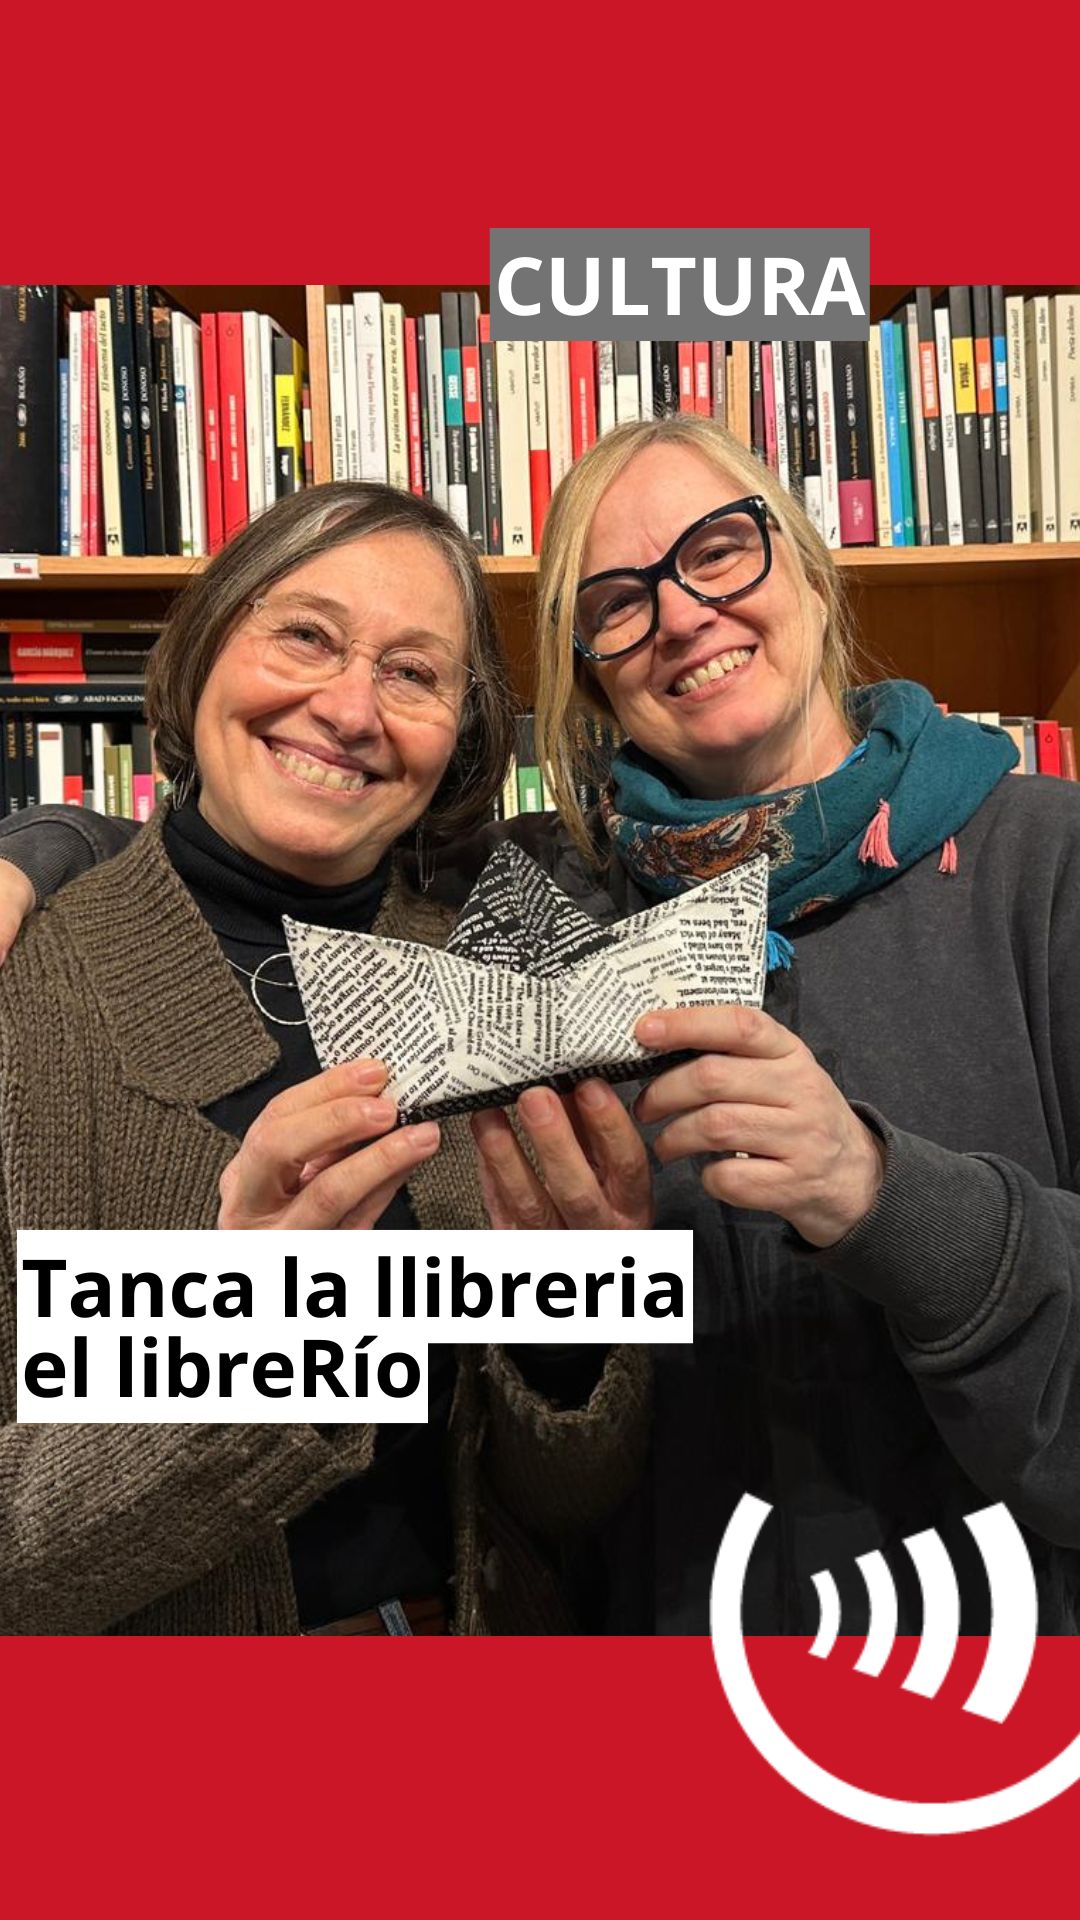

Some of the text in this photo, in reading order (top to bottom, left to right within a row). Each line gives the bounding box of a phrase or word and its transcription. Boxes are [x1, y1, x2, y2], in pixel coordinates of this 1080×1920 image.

[99, 310, 107, 331] tacto
[117, 284, 125, 323] ALFAGUAR
[135, 284, 144, 323] ALFAGUAR
[1011, 308, 1020, 338] infantil
[101, 348, 109, 381] sistema
[1013, 339, 1021, 379] Literatura
[1068, 337, 1076, 360] Poeta
[121, 365, 129, 401] DONOSO
[140, 367, 148, 401] DONOSO
[391, 375, 400, 391] que
[663, 365, 672, 402] MELLADO
[790, 358, 798, 396] MONALISA
[805, 360, 814, 399] RICHARDS
[846, 364, 855, 399] SERRANO
[391, 408, 402, 440] próxima
[946, 414, 954, 448] NÉMESIS
[335, 444, 343, 457] José
[393, 442, 400, 453] La
[83, 694, 146, 703] ABAD FACIOLIN
